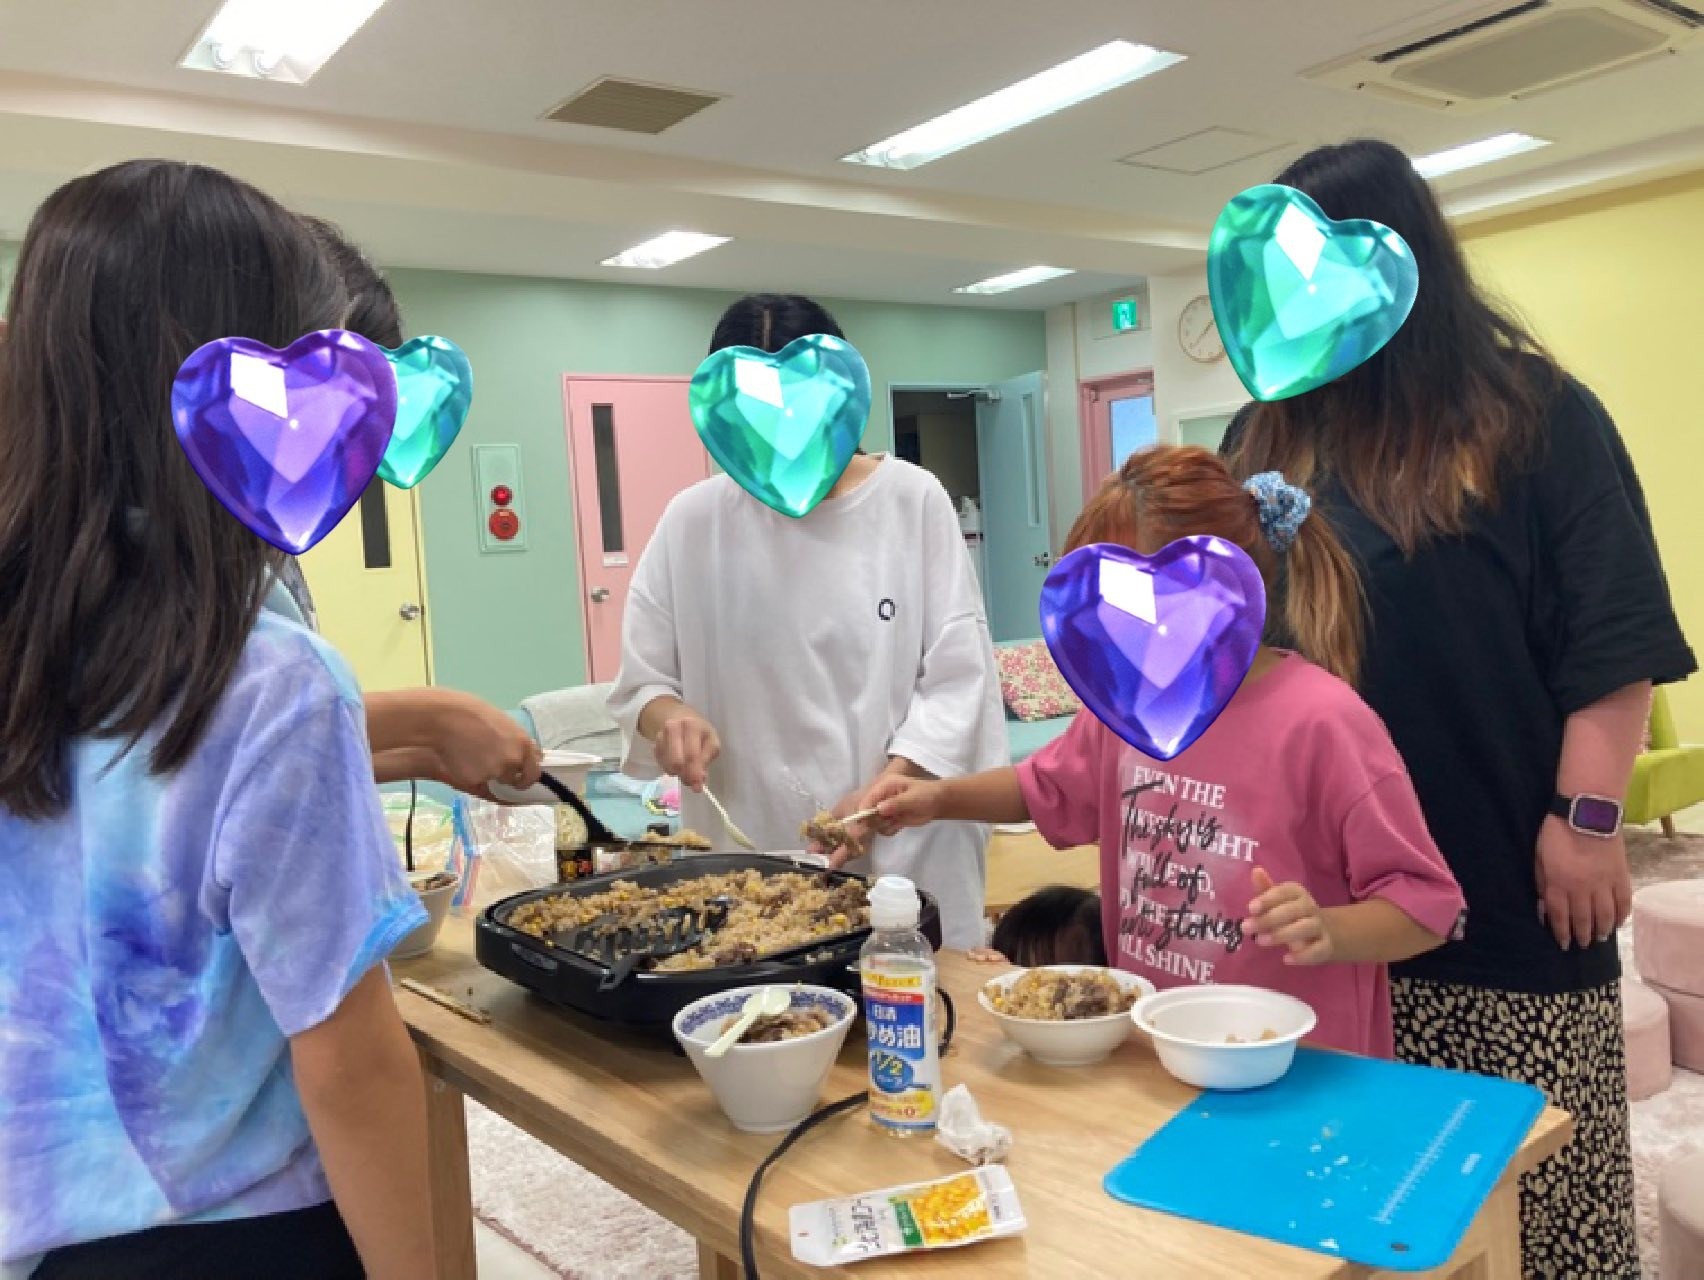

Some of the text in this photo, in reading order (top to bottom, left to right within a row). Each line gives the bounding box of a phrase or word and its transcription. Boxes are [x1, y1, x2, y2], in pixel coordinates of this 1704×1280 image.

[1134, 765, 1227, 810] EVEN THE
[1145, 943, 1216, 985] SHINE
